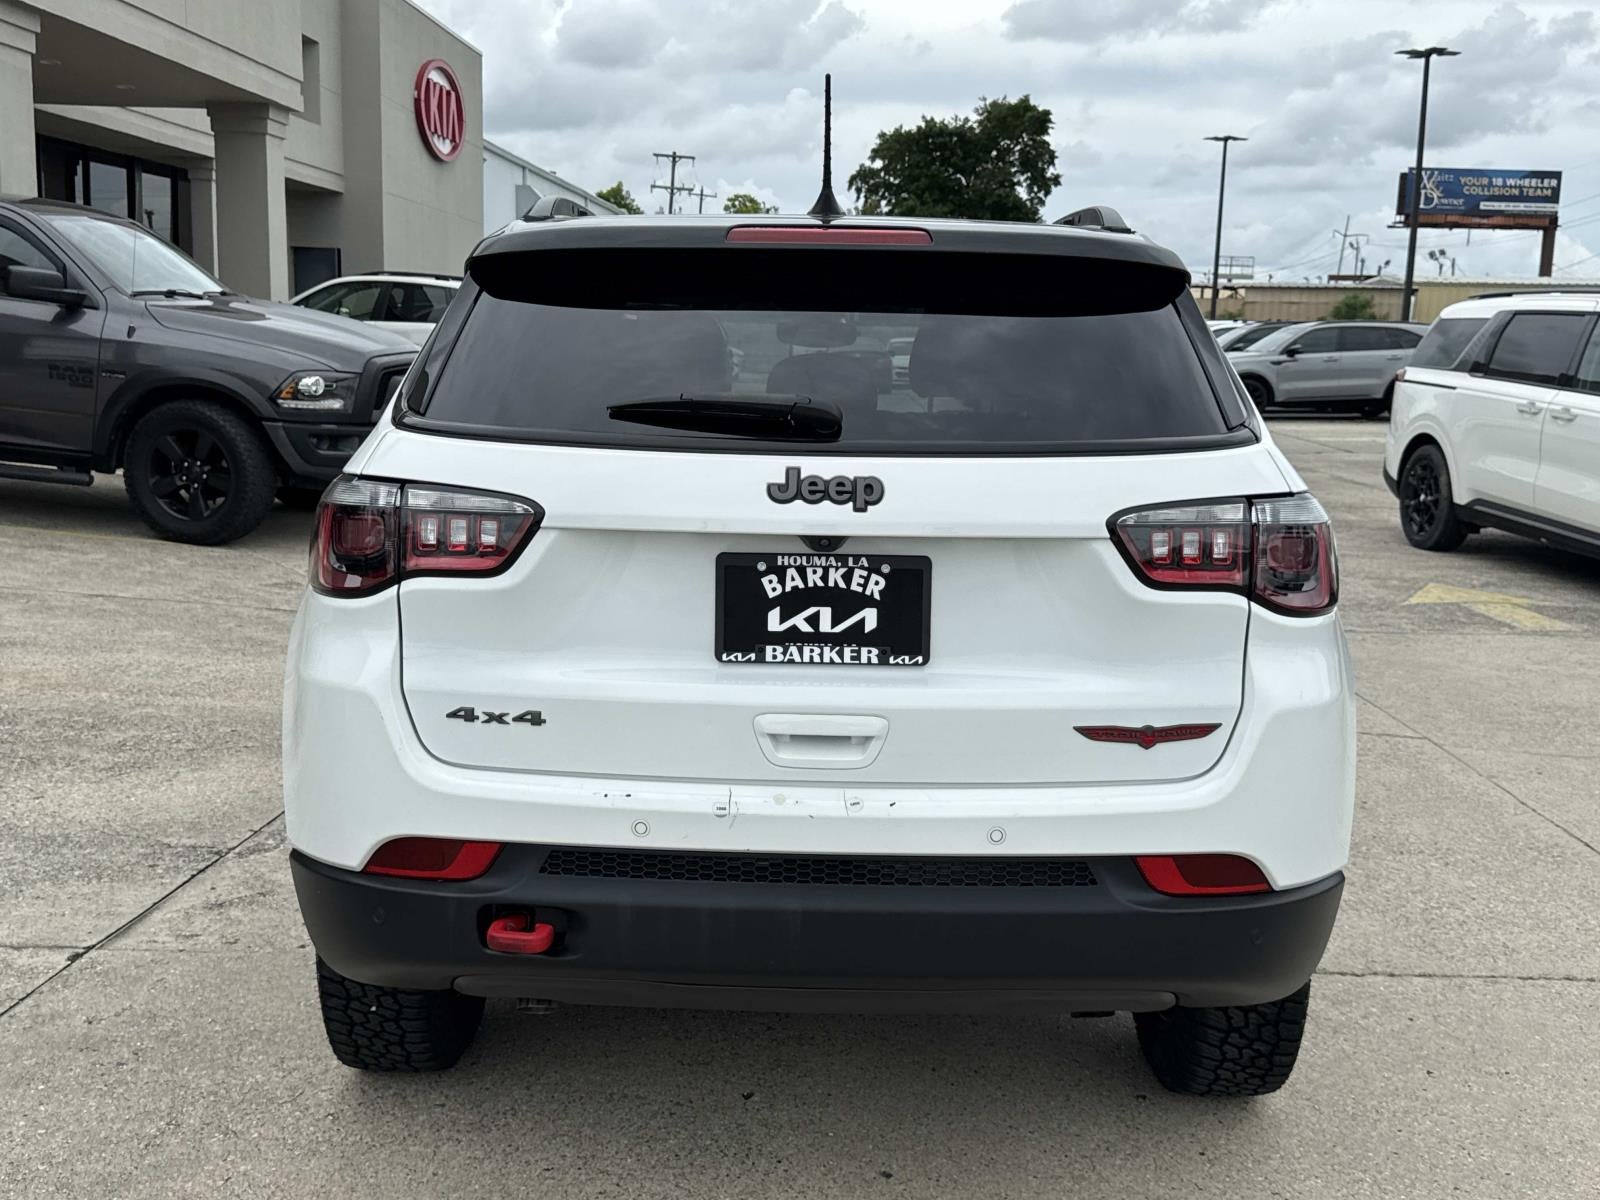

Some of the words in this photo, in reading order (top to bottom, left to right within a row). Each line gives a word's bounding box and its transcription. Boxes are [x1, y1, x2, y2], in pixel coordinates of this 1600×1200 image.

[428, 79, 460, 144] KIA
[1459, 176, 1488, 186] YOUR
[1492, 177, 1503, 186] 18
[1506, 178, 1558, 188] WHEELER
[1463, 186, 1520, 196] COLLISION
[1523, 187, 1552, 197] TEAM
[767, 466, 885, 512] Jeep
[777, 556, 842, 567] HOUMA,
[848, 556, 869, 567] LA
[761, 567, 886, 601] BARKER
[767, 606, 878, 634] KIA
[765, 645, 879, 664] BARKER
[445, 706, 547, 726] 4x4
